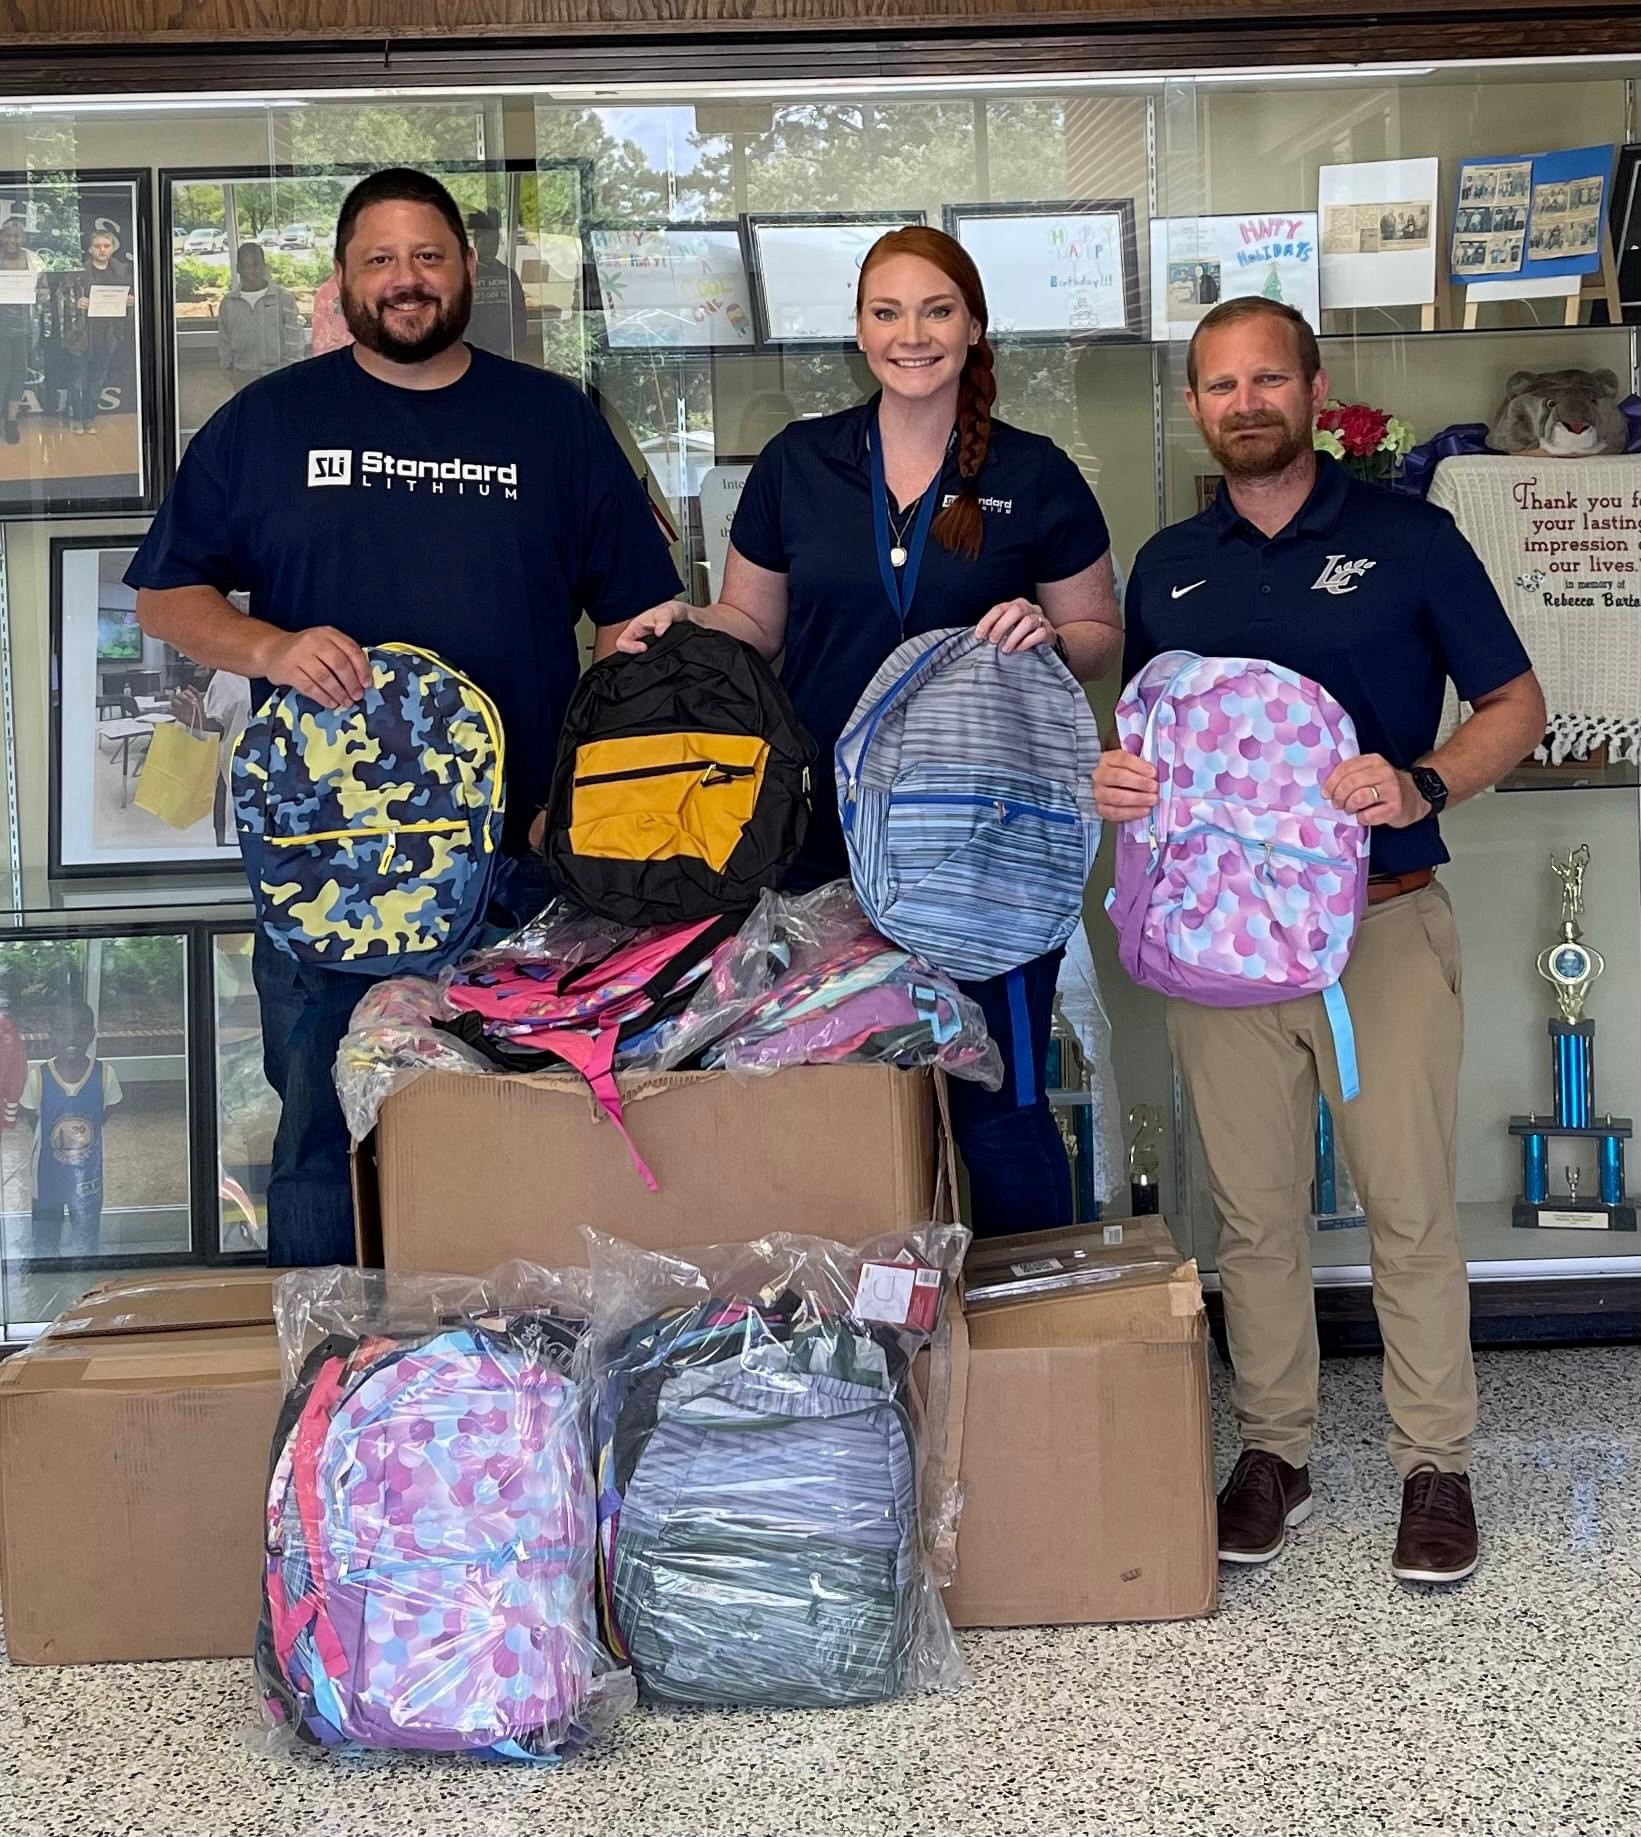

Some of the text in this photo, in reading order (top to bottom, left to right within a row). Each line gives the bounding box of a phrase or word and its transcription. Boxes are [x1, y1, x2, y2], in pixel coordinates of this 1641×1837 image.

[361, 451, 517, 485] Standard
[362, 475, 517, 500] LITHIUM
[1513, 477, 1578, 509] Thank
[1587, 497, 1622, 513] you
[978, 497, 1012, 509] ndard
[1532, 512, 1641, 535] your lastin
[1524, 537, 1628, 556] impression
[1549, 561, 1581, 573] our
[1542, 592, 1595, 608] Rebecca
